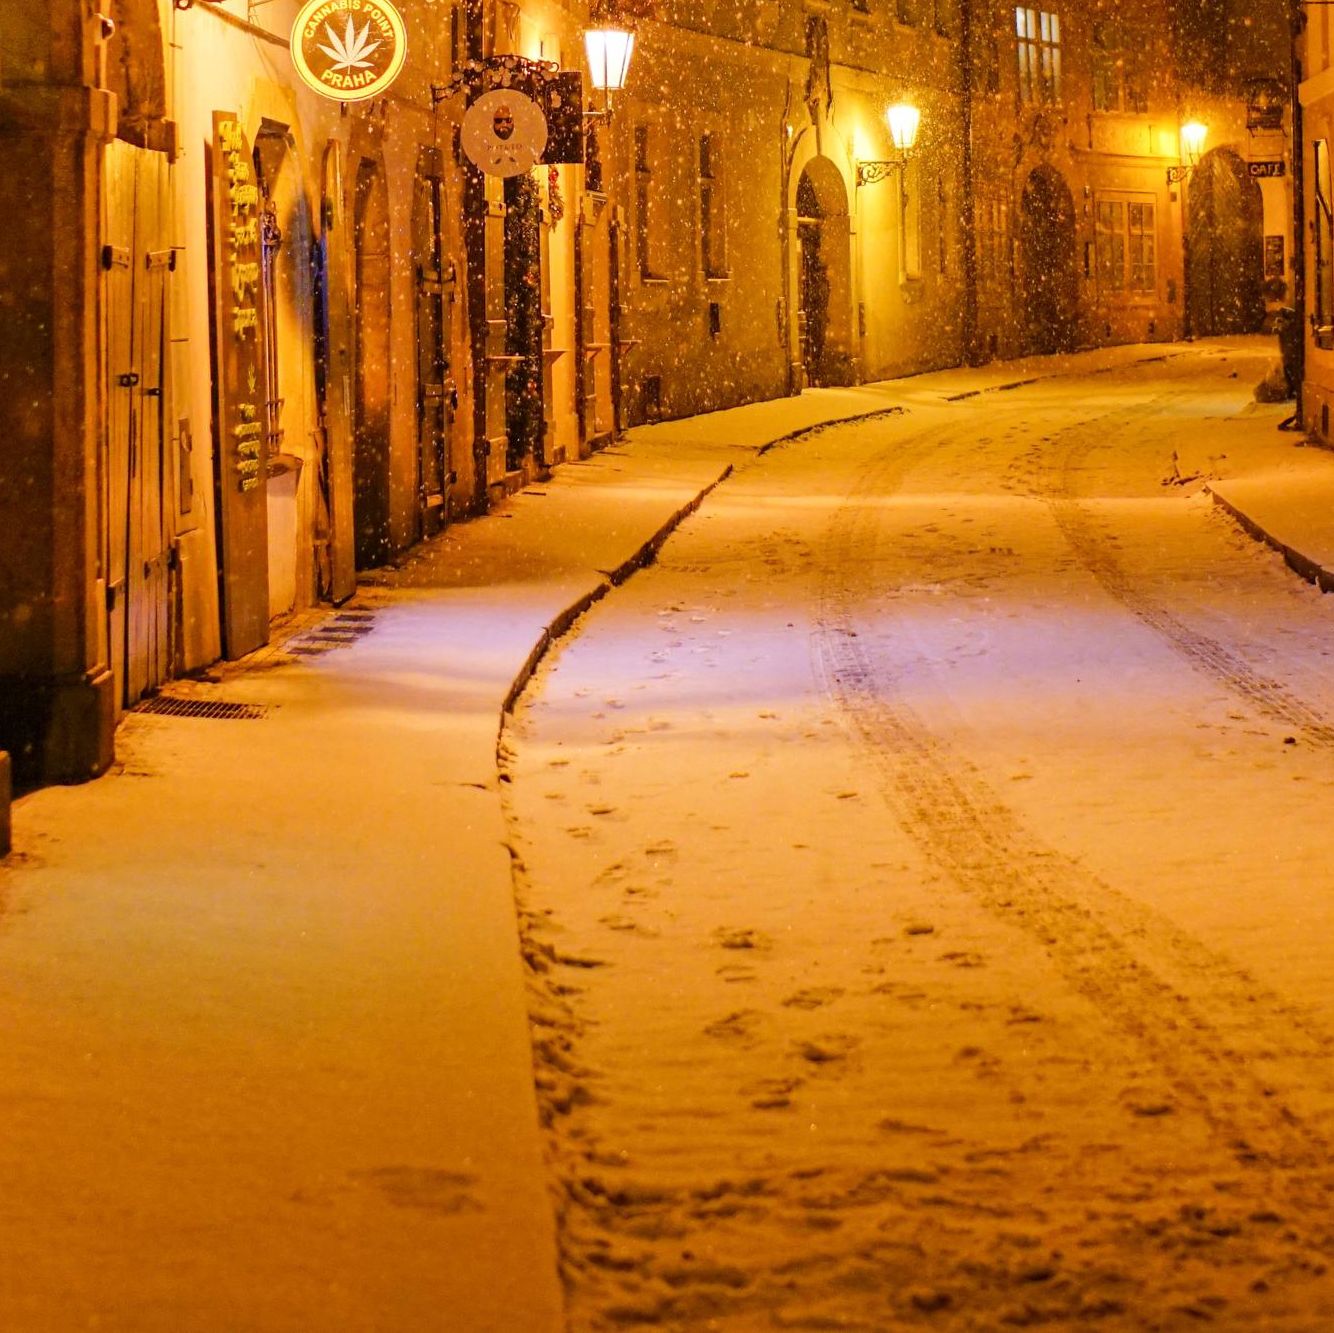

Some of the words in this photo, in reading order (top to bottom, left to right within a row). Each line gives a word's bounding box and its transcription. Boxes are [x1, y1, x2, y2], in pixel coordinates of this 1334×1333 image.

[304, 0, 361, 39] CANNABIS
[362, 3, 394, 39] POINT
[320, 68, 378, 88] PRAHA
